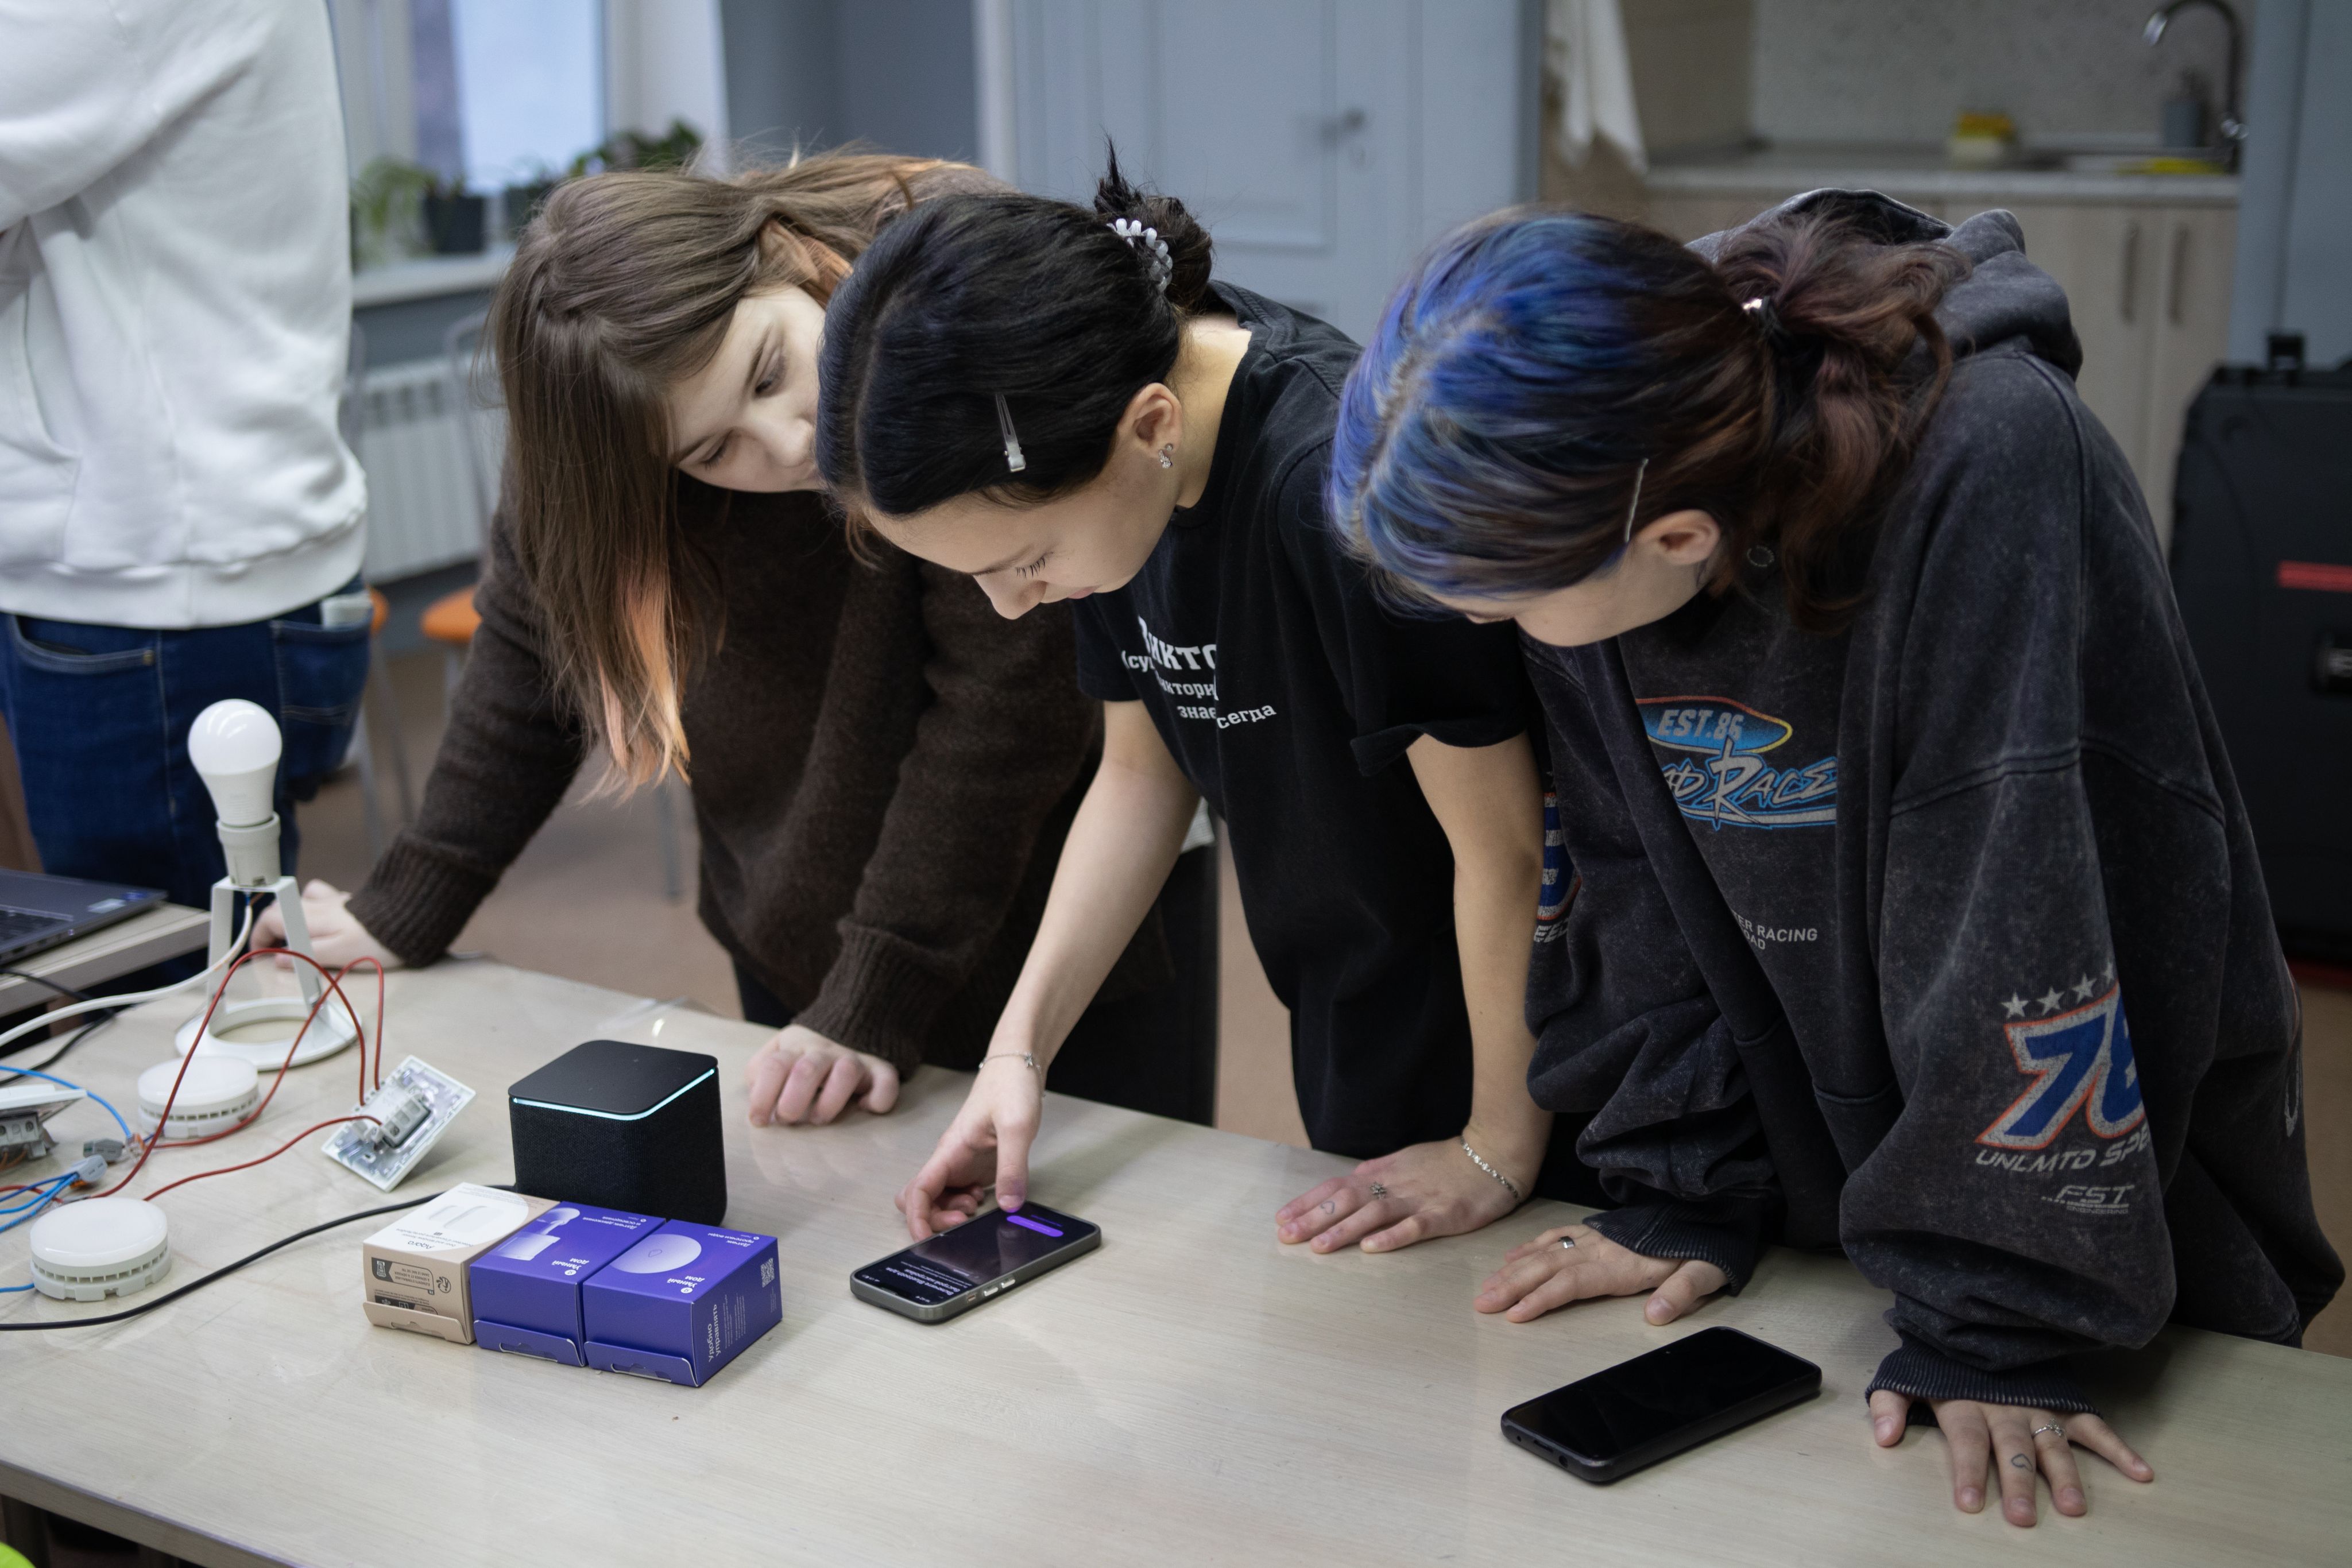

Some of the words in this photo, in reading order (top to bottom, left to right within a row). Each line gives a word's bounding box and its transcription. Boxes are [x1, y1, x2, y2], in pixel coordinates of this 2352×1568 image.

[1177, 706, 1217, 719] знае
[1217, 704, 1277, 729] сегда
[1657, 709, 1745, 741] EST.86
[1662, 761, 1708, 800] AD
[1702, 737, 1838, 826] RACE
[1743, 929, 1766, 950] OAD
[1757, 924, 1818, 942] RACING
[1975, 1148, 2096, 1172] UNLMTD
[2099, 1121, 2152, 1167] SPE
[407, 1240, 435, 1250] Aqara
[724, 1235, 755, 1244] протечки
[726, 1239, 751, 1248] Датчик
[552, 1260, 582, 1270] Умный
[667, 1277, 698, 1288] Умный
[713, 1304, 721, 1357] управлять
